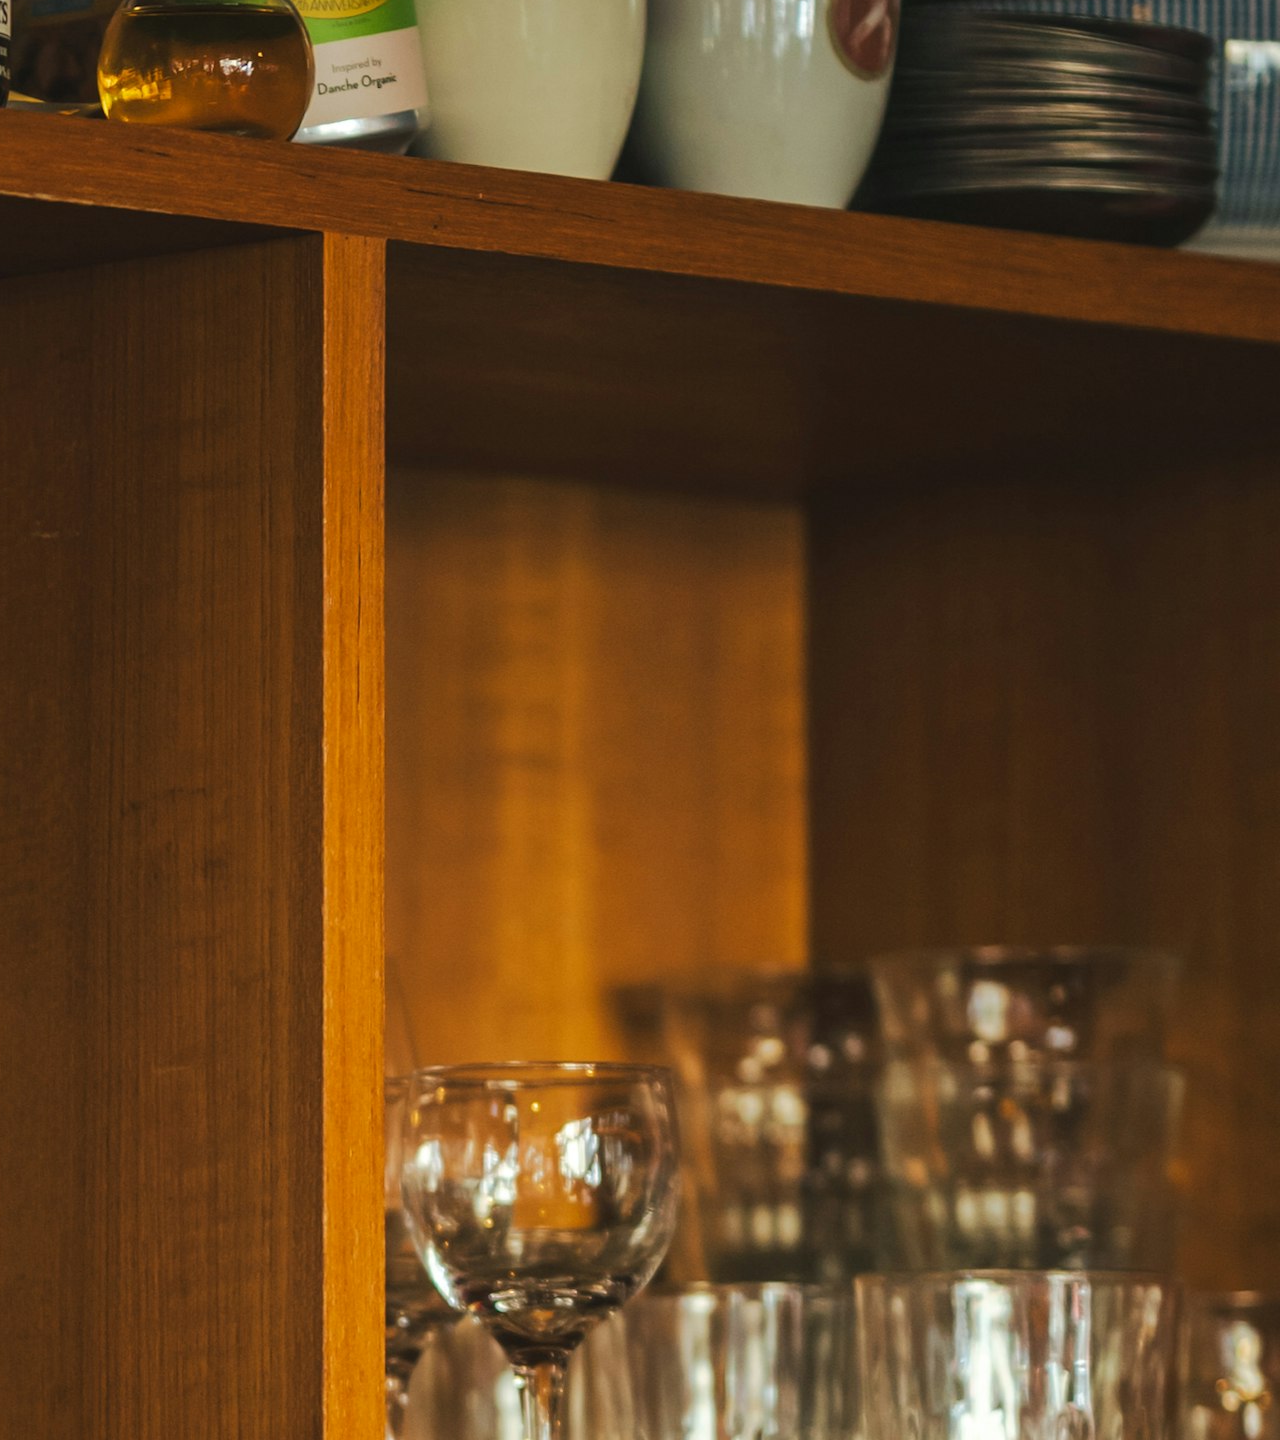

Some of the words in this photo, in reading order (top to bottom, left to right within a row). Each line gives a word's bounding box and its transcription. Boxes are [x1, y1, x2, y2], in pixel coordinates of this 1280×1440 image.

[332, 59, 369, 73] Inspired
[371, 59, 382, 69] by
[317, 78, 359, 95] Danche
[361, 72, 398, 89] Organic
